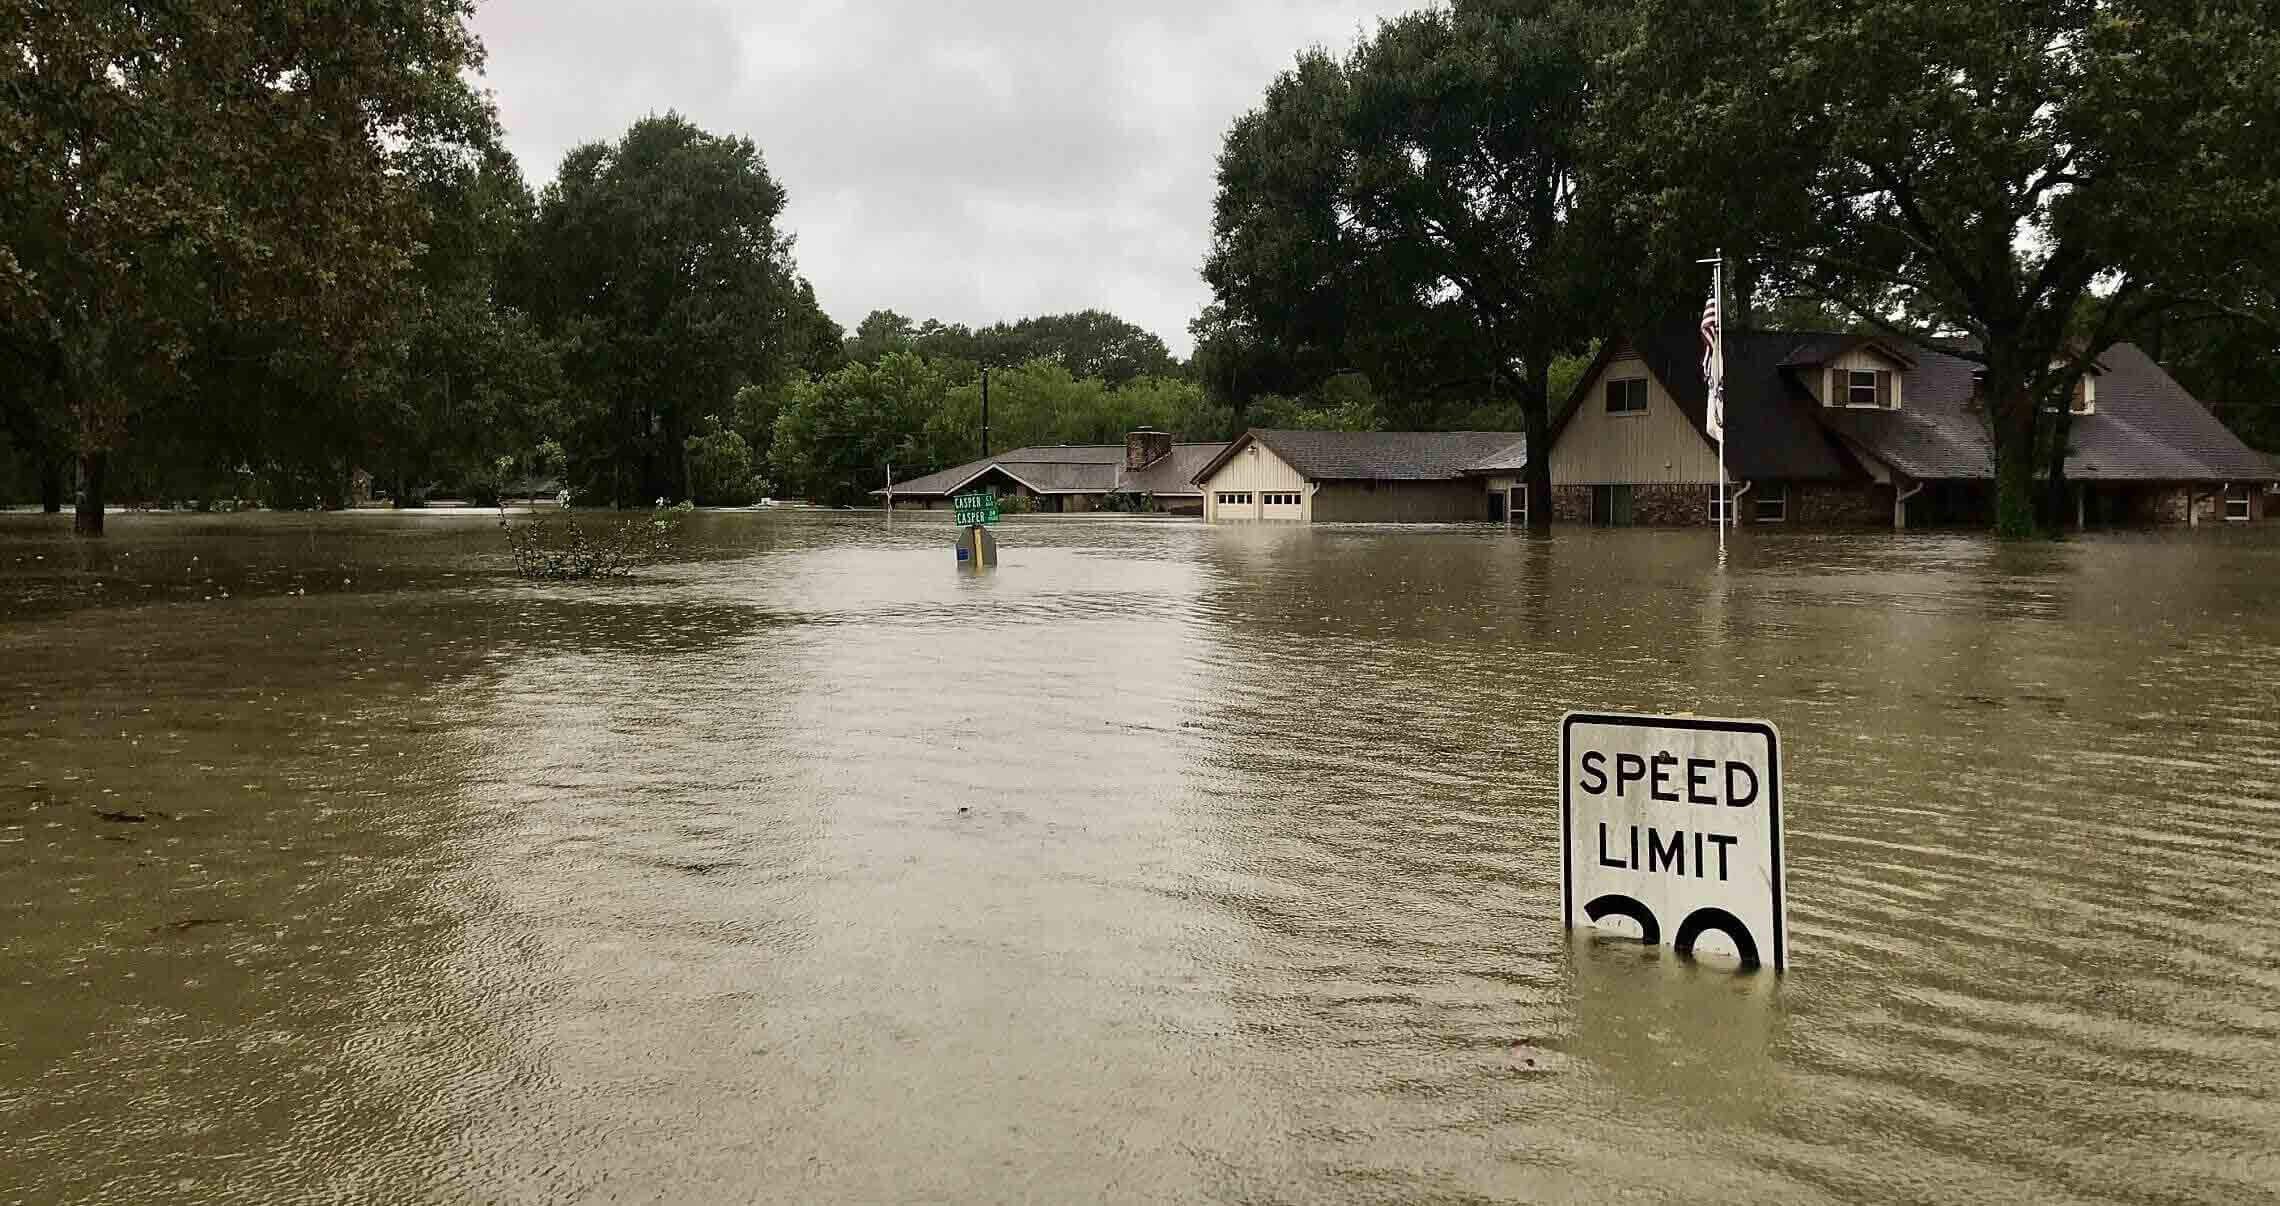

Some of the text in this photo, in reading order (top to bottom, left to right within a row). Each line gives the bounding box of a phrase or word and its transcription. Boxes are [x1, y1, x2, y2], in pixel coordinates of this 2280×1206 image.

[954, 496, 981, 509] CASPER
[957, 511, 985, 524] CASPER
[1579, 750, 1759, 808] SPEED
[1599, 822, 1738, 881] LIMIT
